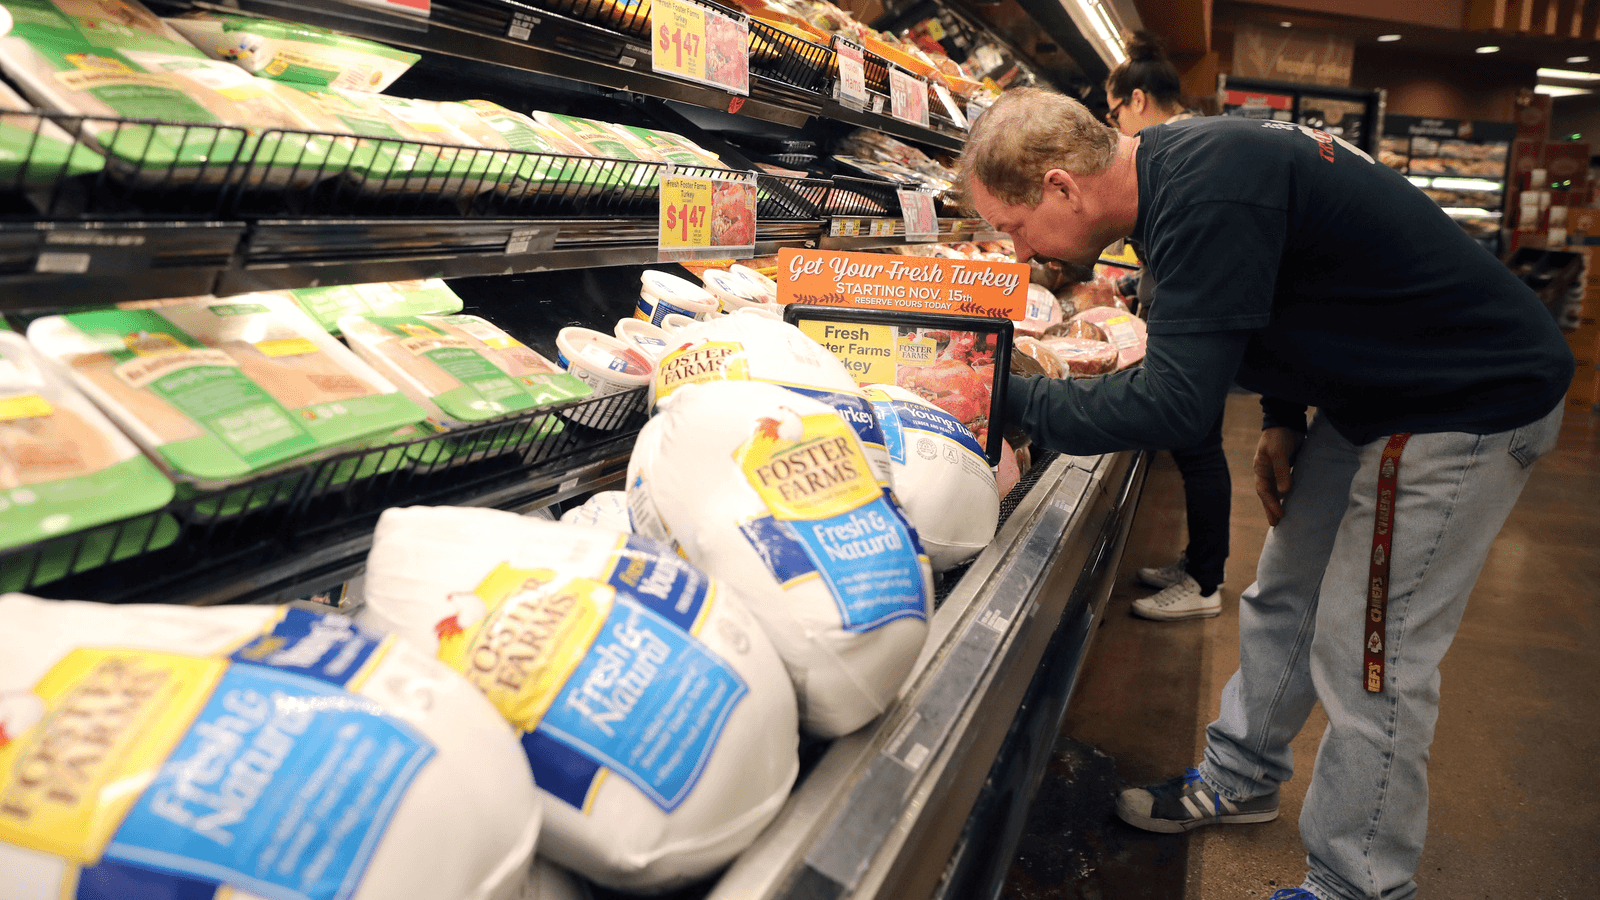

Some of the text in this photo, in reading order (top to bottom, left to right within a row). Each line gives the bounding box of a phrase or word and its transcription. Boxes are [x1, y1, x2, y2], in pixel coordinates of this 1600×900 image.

[672, 2, 686, 13] Foster
[686, 8, 700, 19] Farms
[674, 12, 688, 24] Turkey
[680, 180, 693, 189] Foster
[694, 182, 706, 190] Farms
[681, 190, 694, 199] Turkey
[789, 254, 1020, 296] Get Your Fresh Turkey
[835, 282, 973, 303] STARTING NOV. 15th
[854, 296, 952, 310] RESERVE YOURS TODAY
[824, 325, 869, 341] Fresh
[848, 343, 891, 357] Farms
[899, 344, 932, 354] FOSTER
[660, 348, 732, 376] FOSTER
[840, 405, 874, 429] urkey
[904, 402, 931, 412] Fresh
[904, 407, 955, 432] Young
[756, 436, 854, 487] FOSTER
[812, 510, 887, 545] Fresh &
[822, 525, 903, 562] Natural
[495, 594, 578, 692] FARMS
[564, 643, 632, 718] Fresh
[590, 628, 672, 738] Natural
